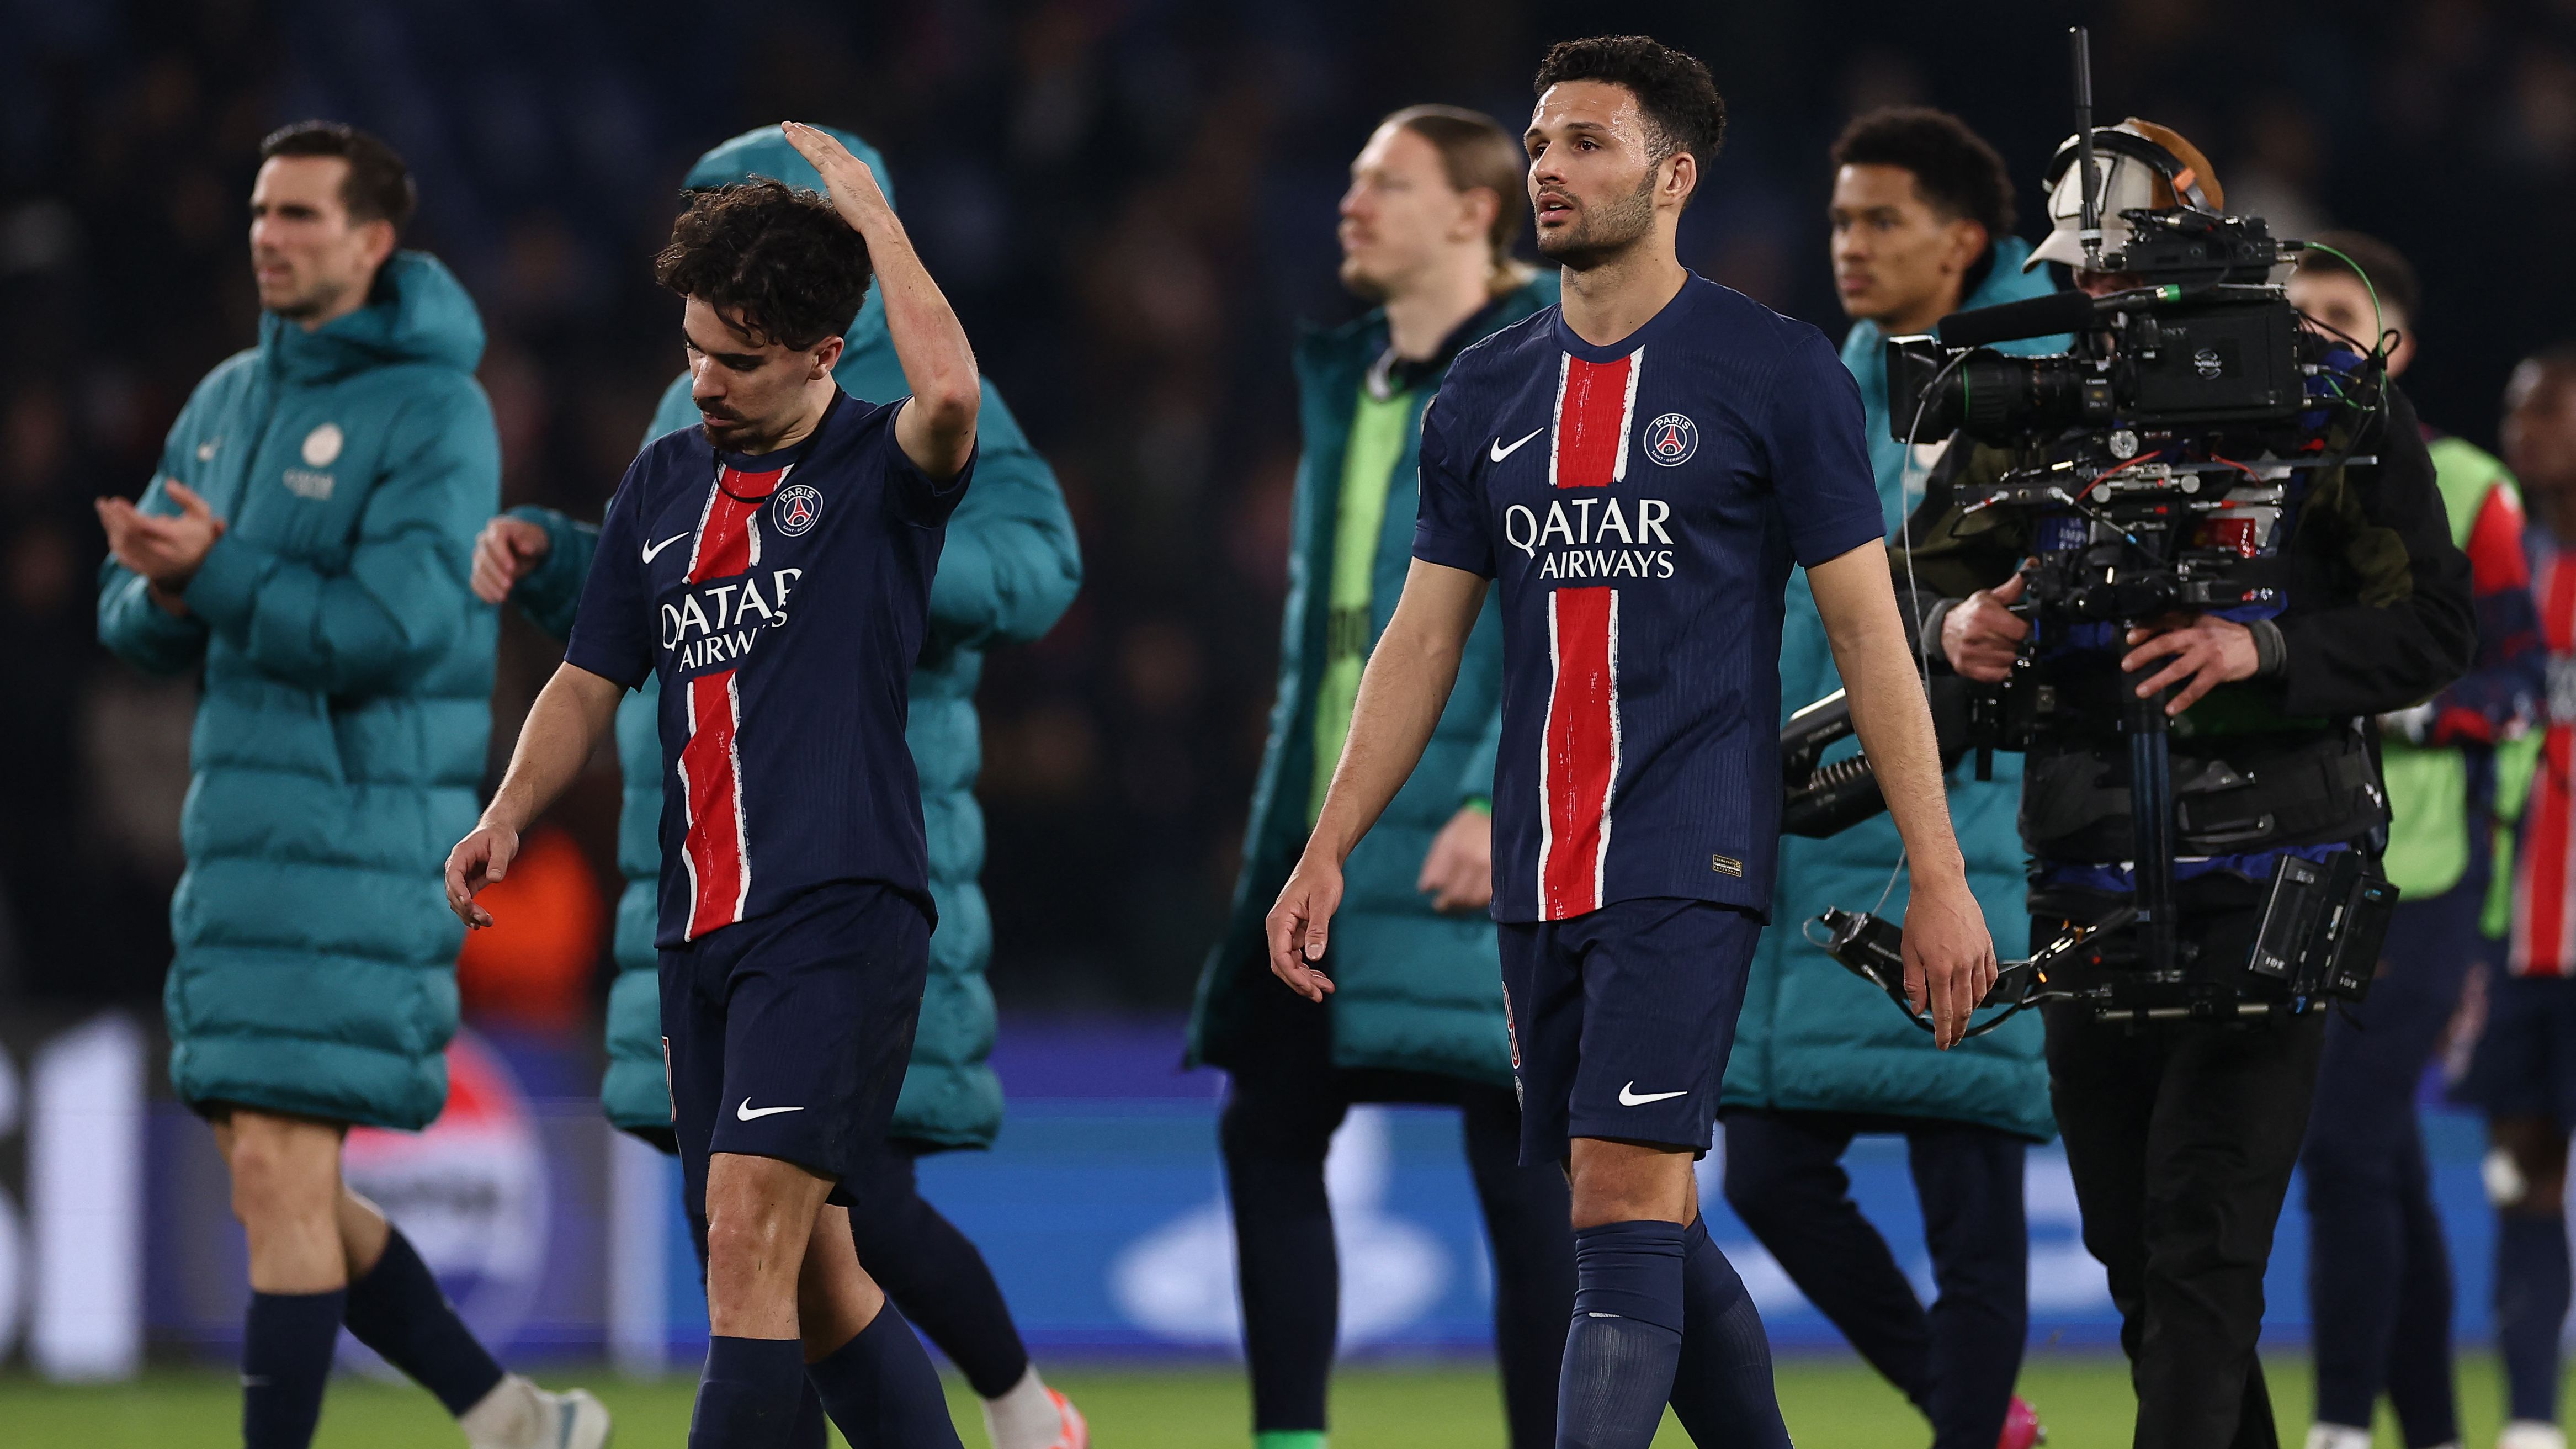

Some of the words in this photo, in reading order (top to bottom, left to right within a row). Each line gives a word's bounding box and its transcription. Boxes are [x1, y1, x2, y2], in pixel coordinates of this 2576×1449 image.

[1655, 416, 1691, 430] PARIS
[780, 487, 815, 503] PARIS
[1505, 497, 1674, 560] QATAR
[1539, 550, 1674, 580] AIRWAYS
[678, 602, 788, 672] AIRWS
